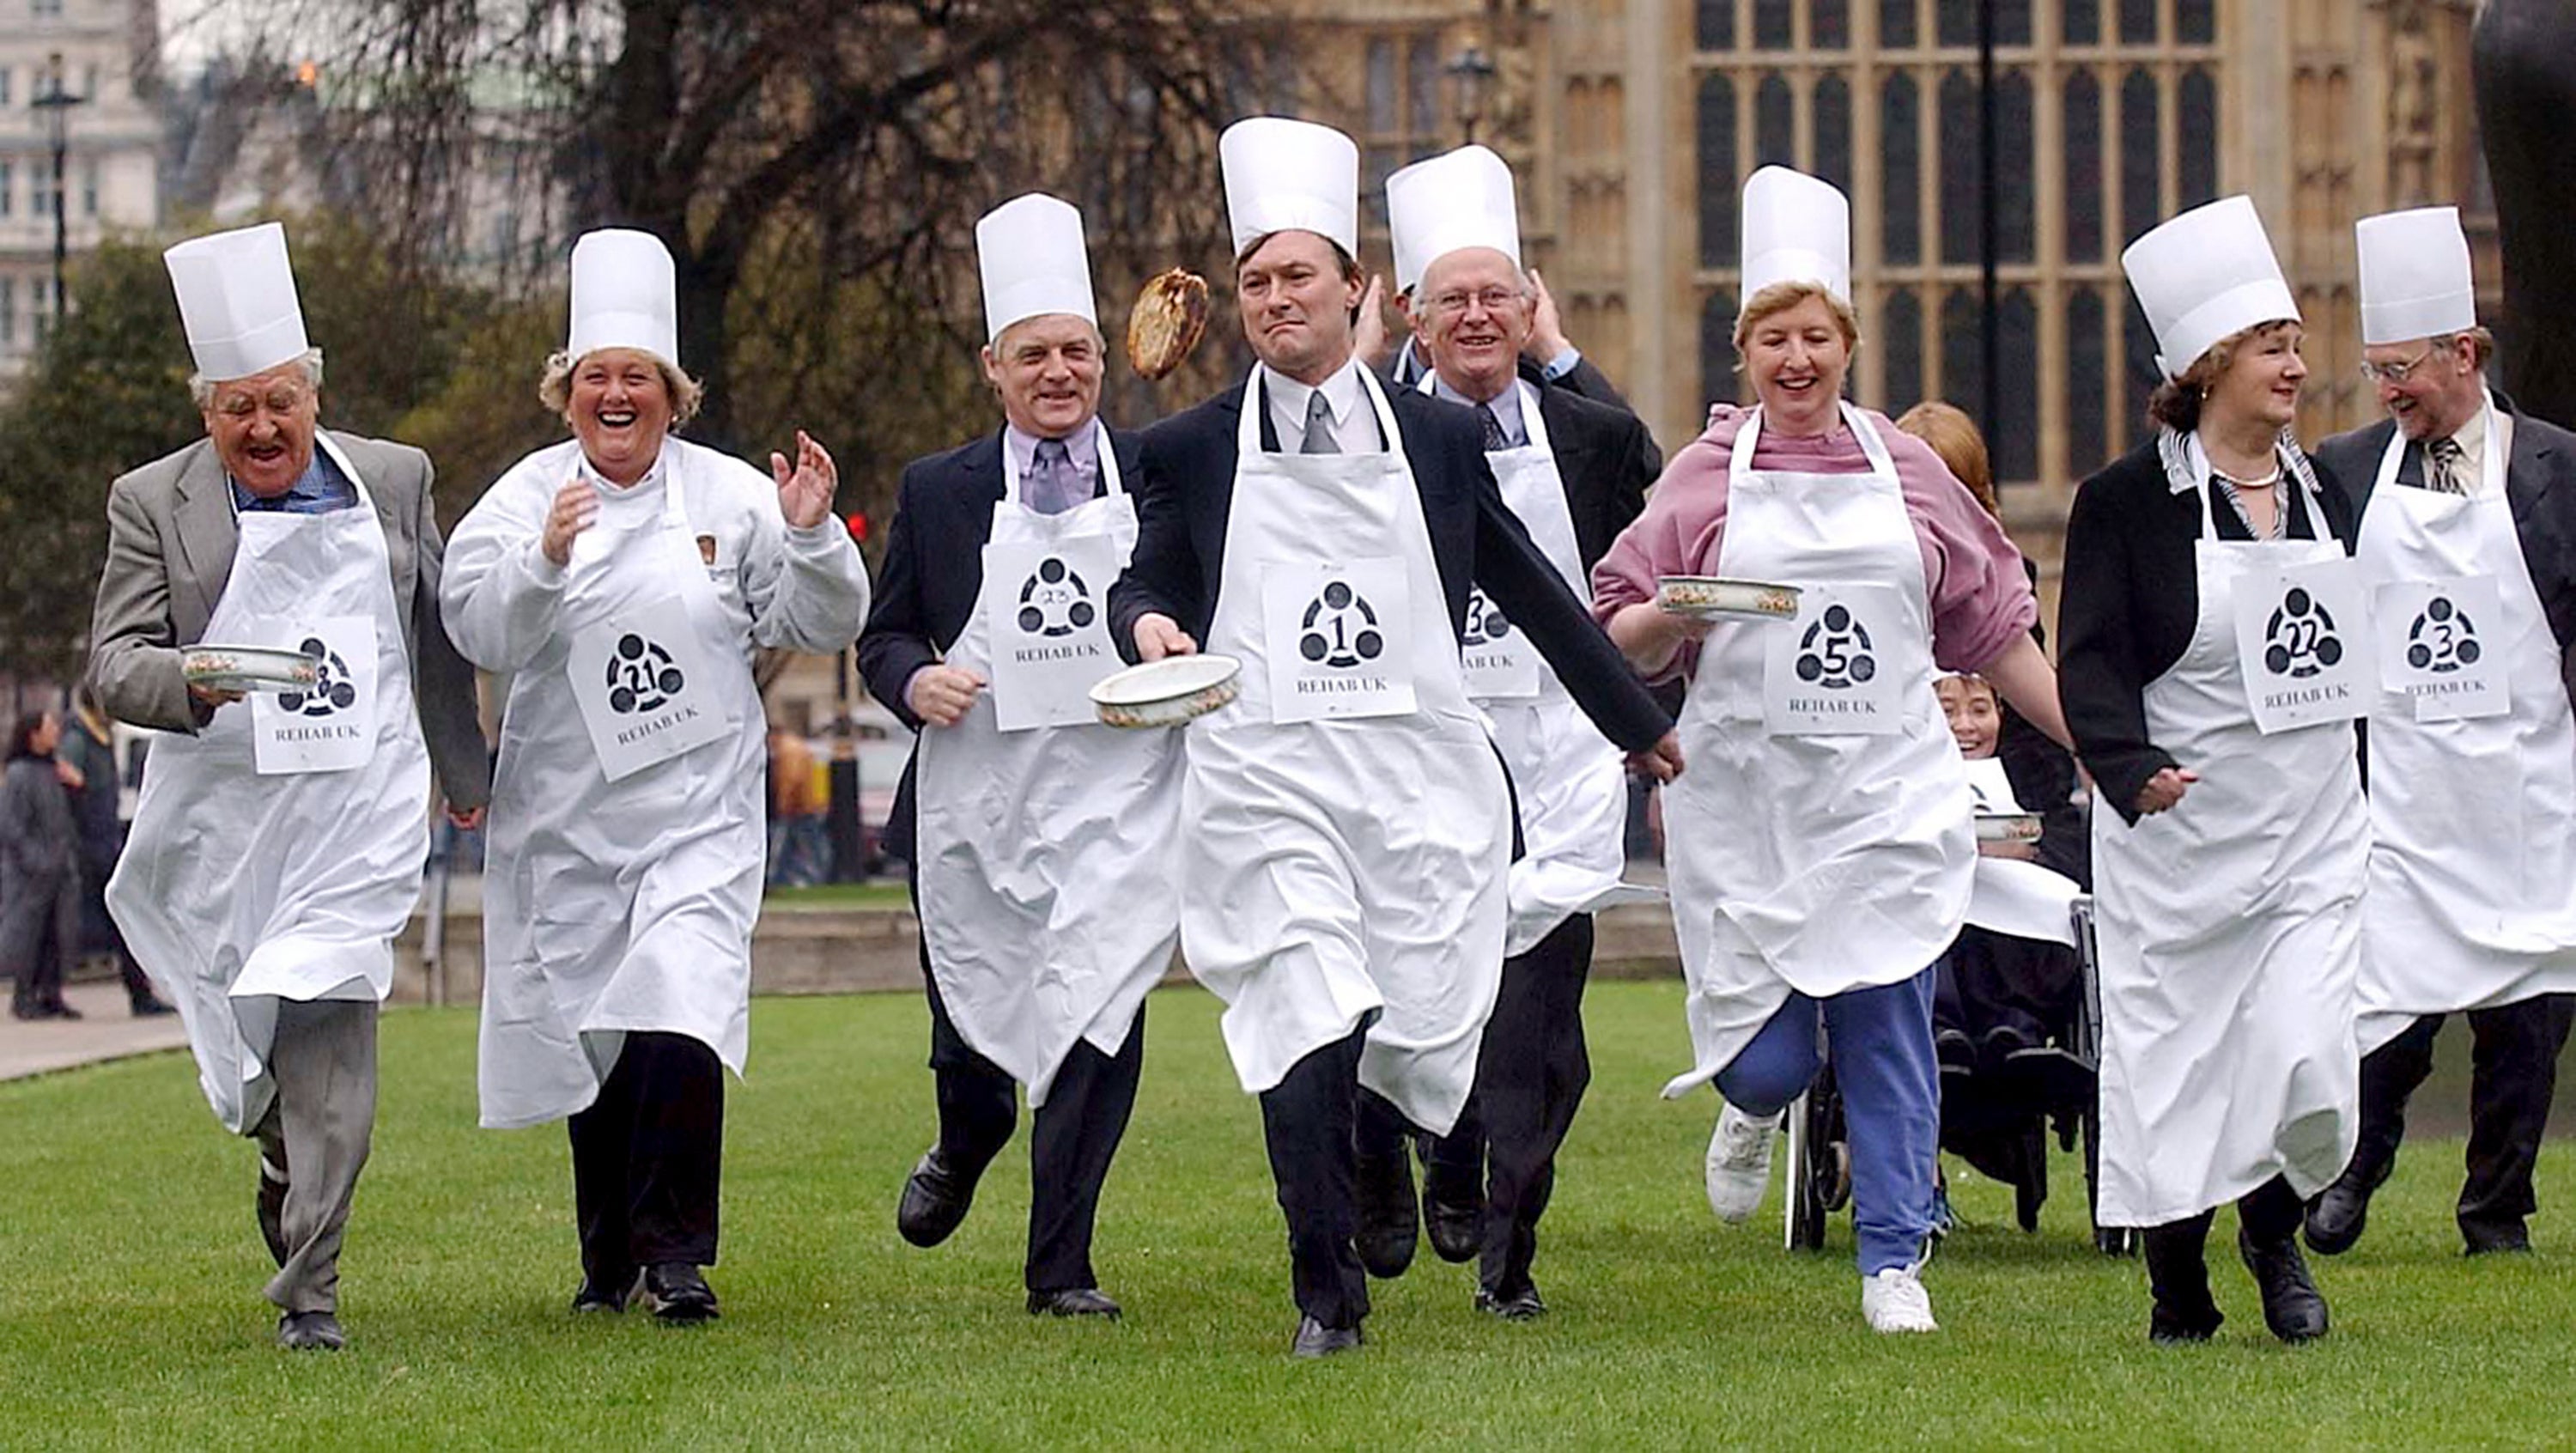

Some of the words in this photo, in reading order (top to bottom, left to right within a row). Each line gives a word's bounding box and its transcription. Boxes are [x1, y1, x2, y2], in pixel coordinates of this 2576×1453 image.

[1040, 589, 1070, 604] 23
[1327, 615, 1349, 652] 1
[2284, 619, 2318, 658] 22
[2433, 624, 2454, 659] 3
[1015, 647, 1072, 662] REHAB
[1076, 644, 1100, 657] UK
[1490, 655, 1515, 668] UK
[1823, 636, 1850, 674] 5
[624, 659, 657, 695] 21
[1297, 679, 1358, 693] REHAB
[1362, 677, 1388, 691] UK
[2462, 679, 2486, 692] UK
[1789, 698, 1847, 713] REHAB
[1852, 700, 1877, 714] UK
[2264, 689, 2321, 708] REHAB
[2324, 685, 2349, 701] UK
[276, 726, 333, 742] REHAB
[337, 725, 361, 739] UK
[617, 714, 672, 745] REHAB
[675, 706, 700, 723] UK
